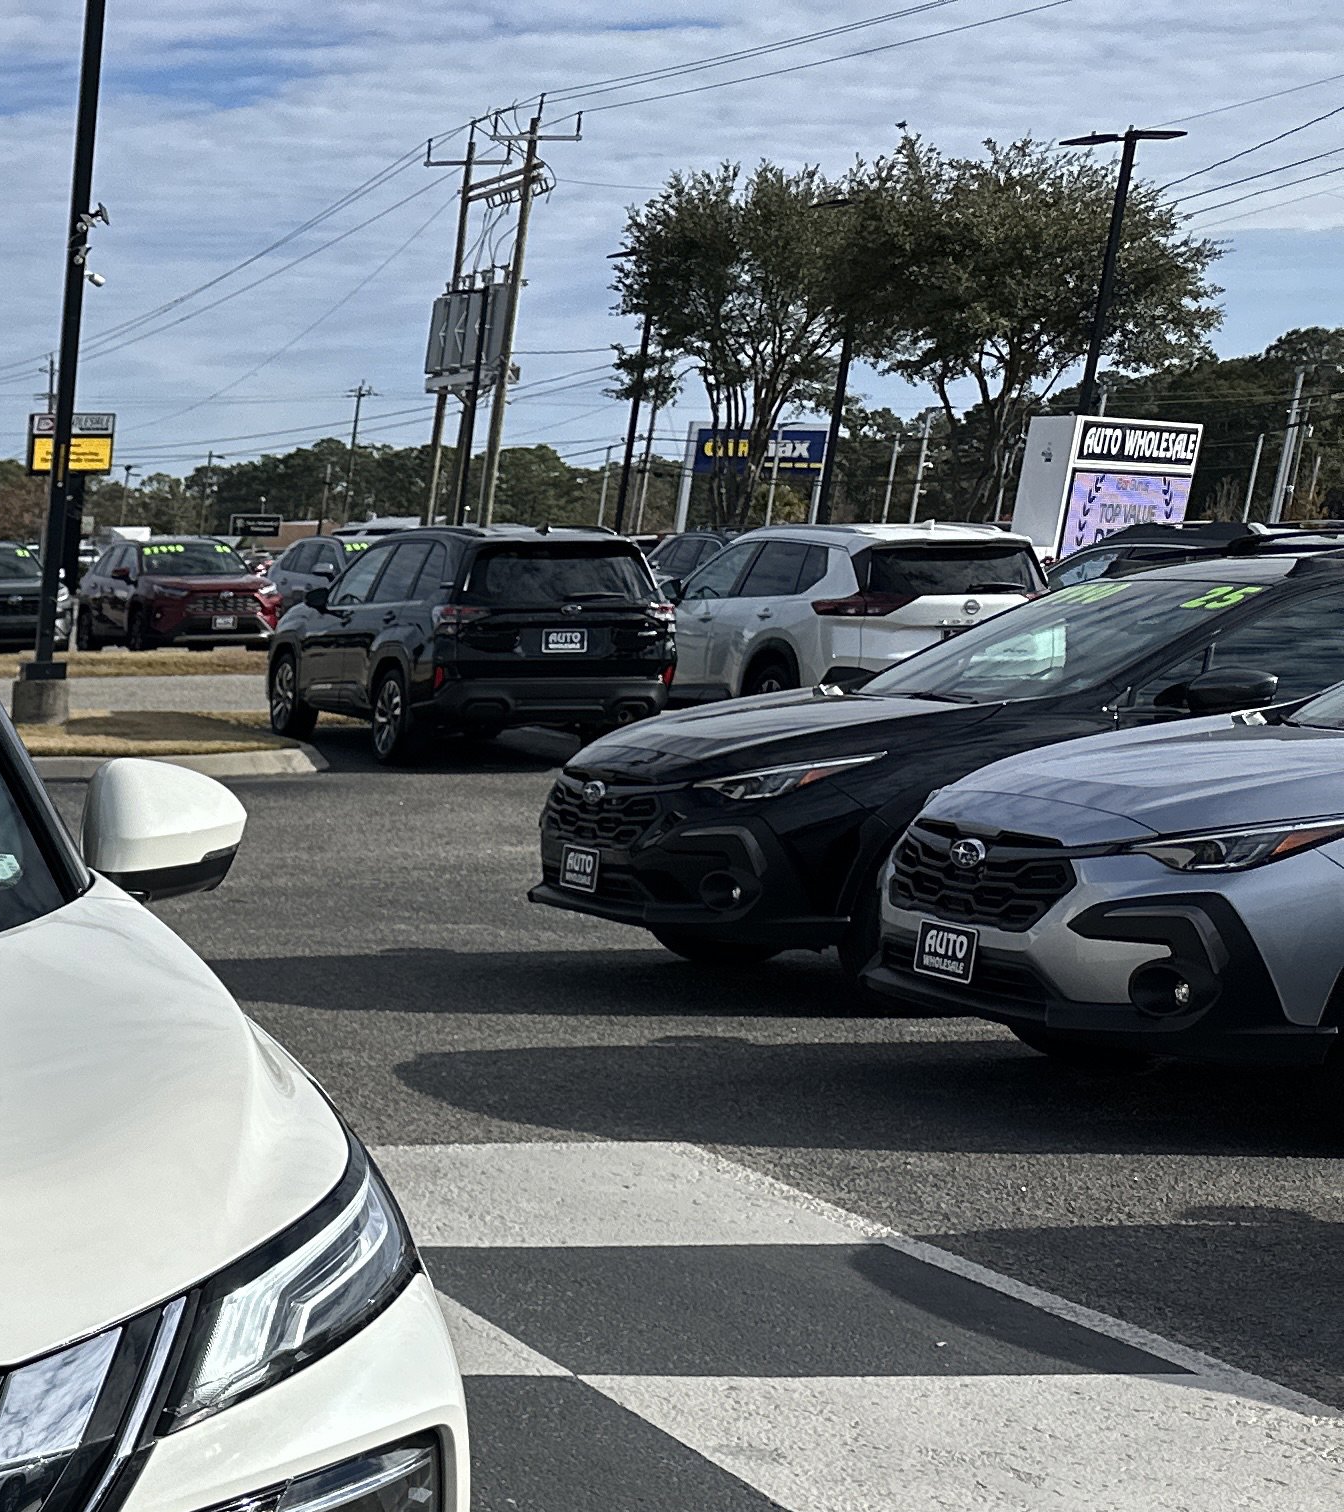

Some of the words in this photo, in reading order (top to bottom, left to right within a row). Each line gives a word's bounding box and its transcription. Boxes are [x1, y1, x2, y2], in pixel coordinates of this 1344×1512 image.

[1083, 427, 1123, 456] AUTO
[1124, 429, 1197, 461] WHOLESALE
[1179, 586, 1267, 611] 25
[548, 632, 581, 643] AUTO
[566, 851, 594, 874] AUTO
[924, 929, 968, 959] AUTO
